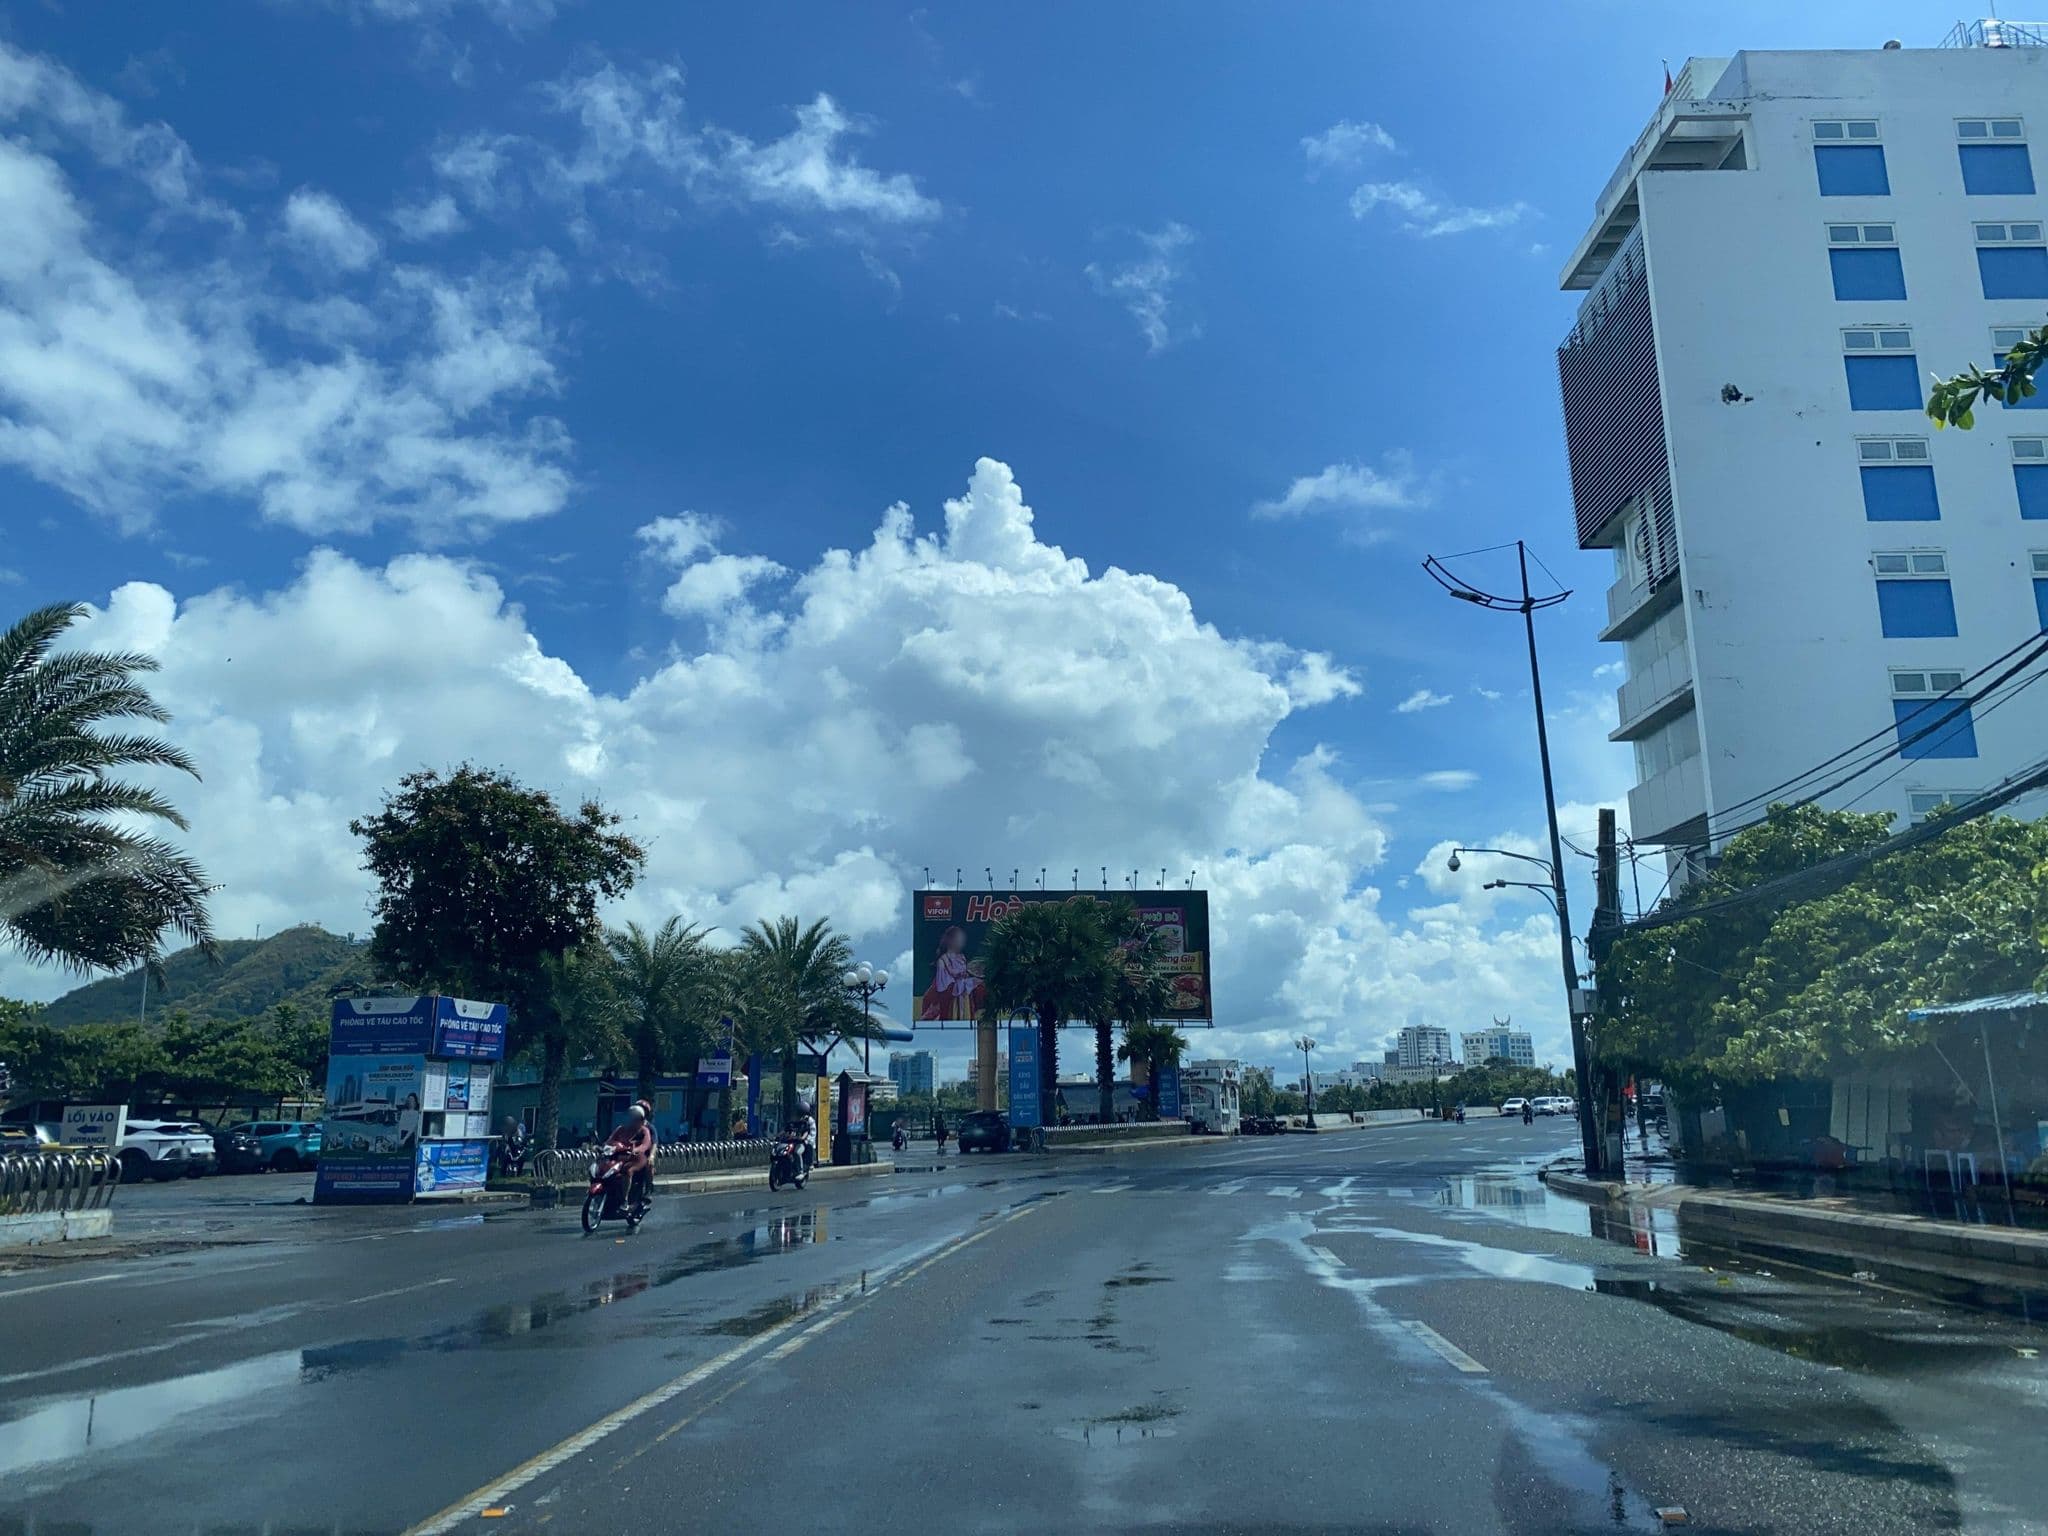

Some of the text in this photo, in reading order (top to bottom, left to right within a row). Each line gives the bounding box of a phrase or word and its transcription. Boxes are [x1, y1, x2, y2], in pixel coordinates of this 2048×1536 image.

[392, 1017, 407, 1025] CAO
[68, 1109, 114, 1122] LỐI VÀO
